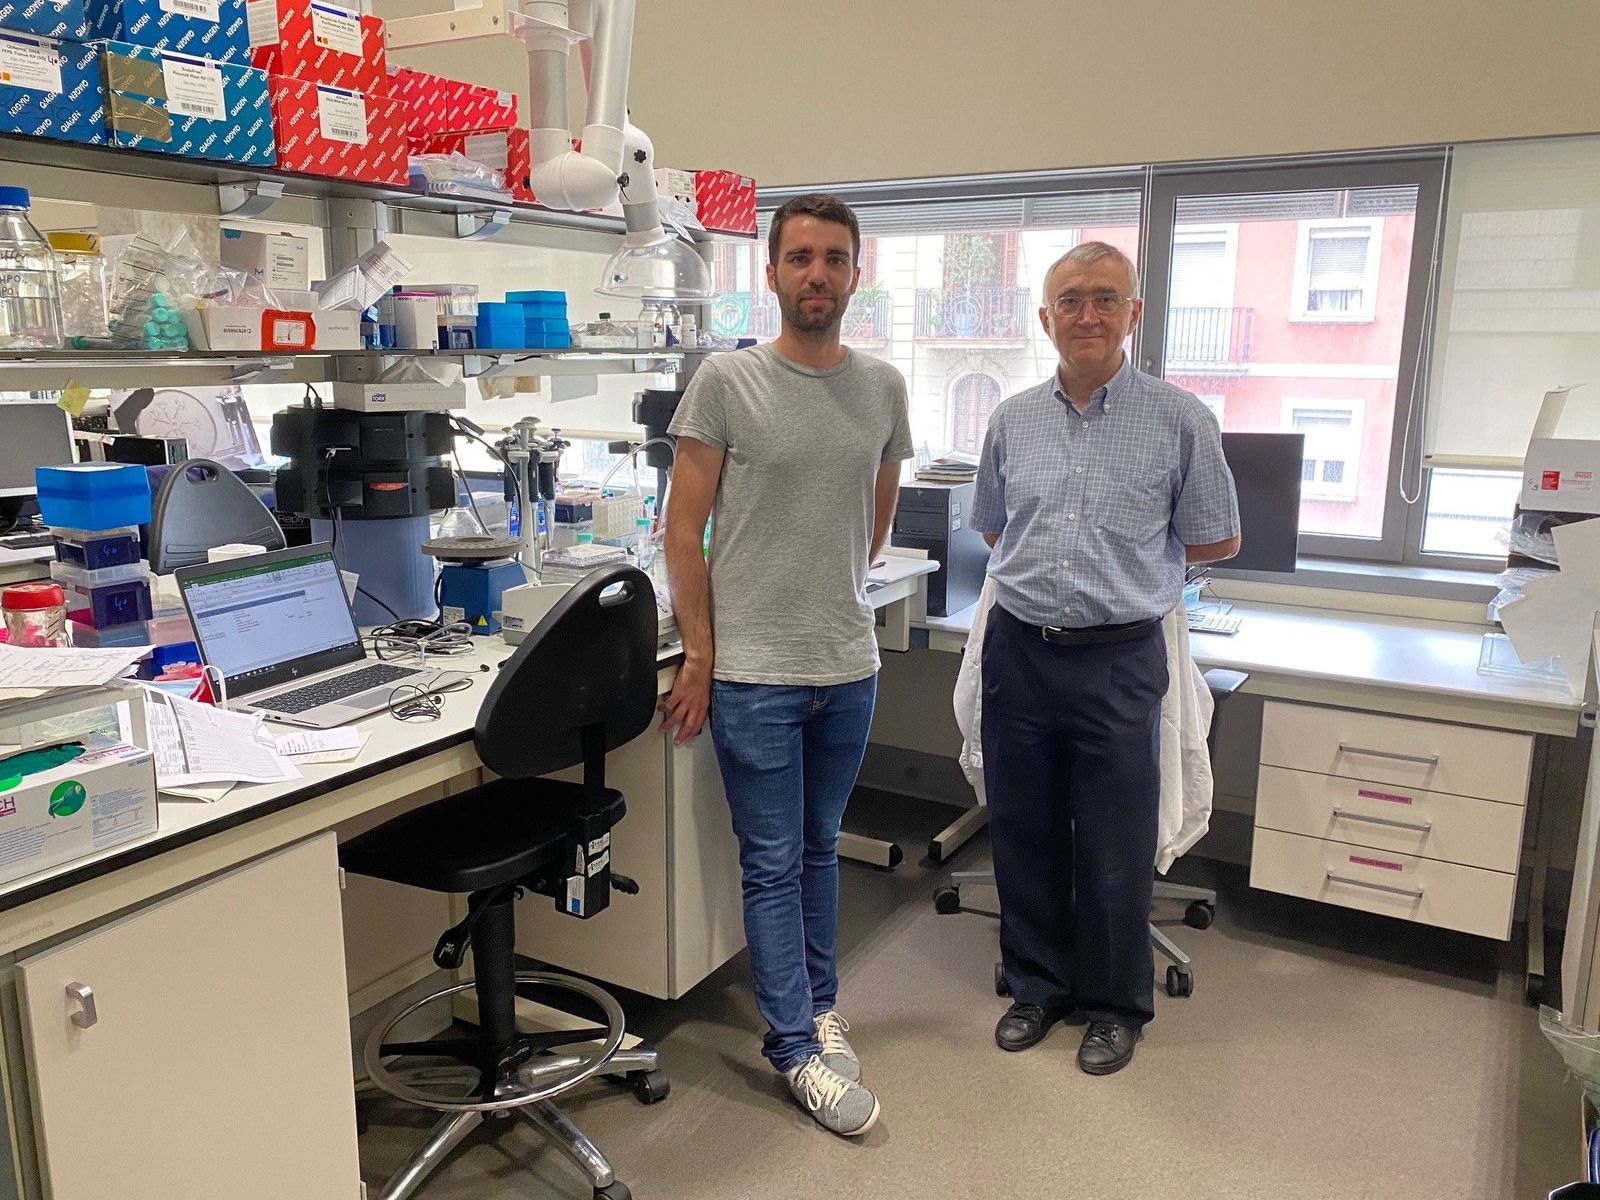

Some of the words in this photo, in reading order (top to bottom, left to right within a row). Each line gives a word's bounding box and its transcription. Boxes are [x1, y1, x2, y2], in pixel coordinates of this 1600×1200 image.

[130, 13, 150, 34] QIAGEN
[226, 17, 244, 38] QIAGEN
[279, 9, 295, 30] QIAGEN
[176, 30, 195, 51] QIAGEN
[202, 24, 220, 44] QIAGEN
[297, 28, 312, 50] QIAGEN
[77, 45, 98, 70] QIAGEN
[314, 48, 330, 69] QIAGEN
[372, 47, 384, 66] QIAGEN
[352, 58, 366, 77] QIAGEN
[236, 68, 254, 88] QIAGEN
[68, 79, 88, 102] QIAGEN
[252, 89, 268, 110] QIAGEN
[295, 81, 312, 100] QIAGEN
[8, 94, 30, 116] QIAGEN
[230, 96, 248, 117] QIAGEN
[384, 102, 398, 119] QIAGEN
[60, 110, 82, 132] QIAGEN
[289, 107, 305, 126] QIAGEN
[223, 124, 241, 146] QIAGEN
[247, 117, 264, 138] QIAGEN
[304, 127, 320, 146] QIAGEN
[378, 126, 392, 144] QIAGEN
[199, 132, 218, 153] QIAGEN
[283, 134, 299, 154] QIAGEN
[318, 146, 334, 166] QIAGEN
[372, 151, 386, 169] QIAGEN
[391, 146, 404, 162] QIAGEN
[354, 158, 368, 176] QIAGEN
[278, 514, 305, 525] Reply
